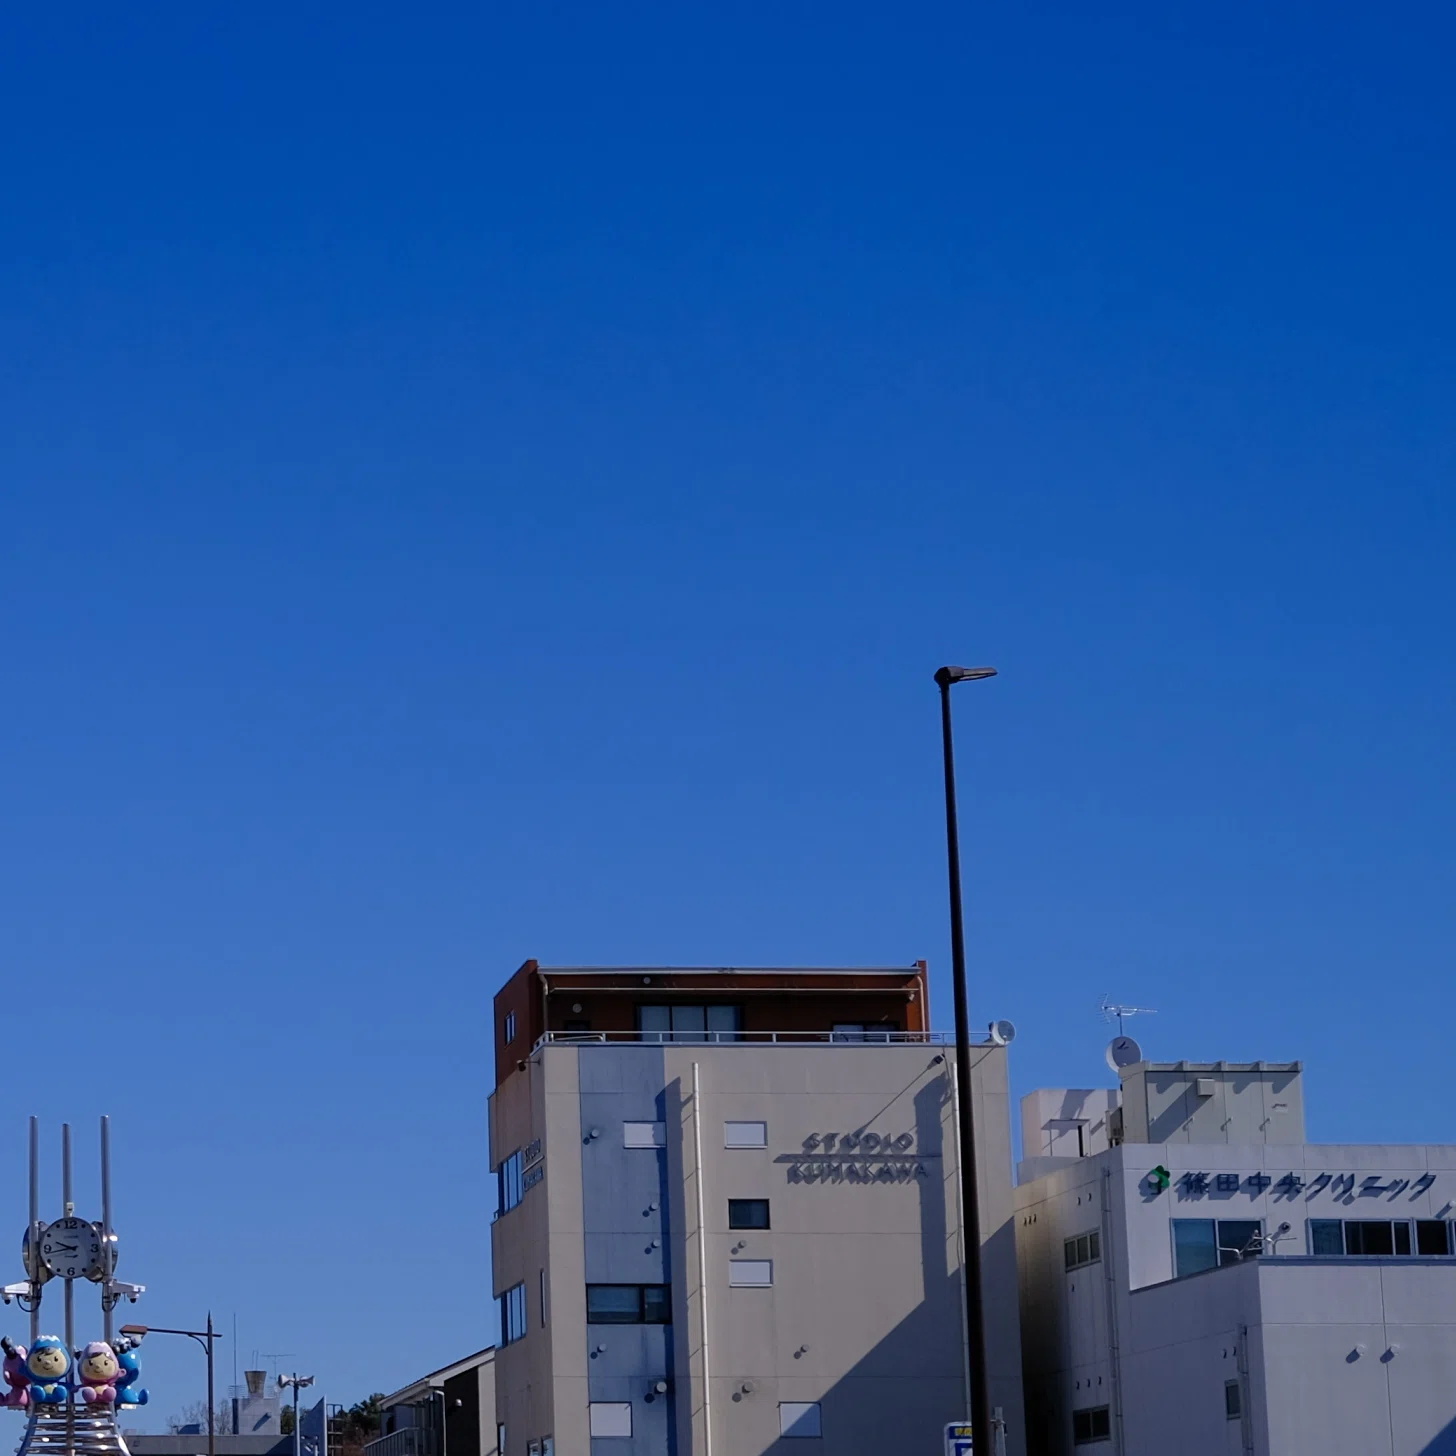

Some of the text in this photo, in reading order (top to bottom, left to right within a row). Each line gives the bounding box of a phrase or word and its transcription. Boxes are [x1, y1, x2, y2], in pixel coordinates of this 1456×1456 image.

[805, 1132, 914, 1152] STUDIO
[789, 1162, 928, 1182] KUMAKAWA
[64, 1220, 78, 1229] 12
[44, 1244, 52, 1253] 9
[90, 1244, 99, 1253] 3
[67, 1267, 75, 1276] 6
